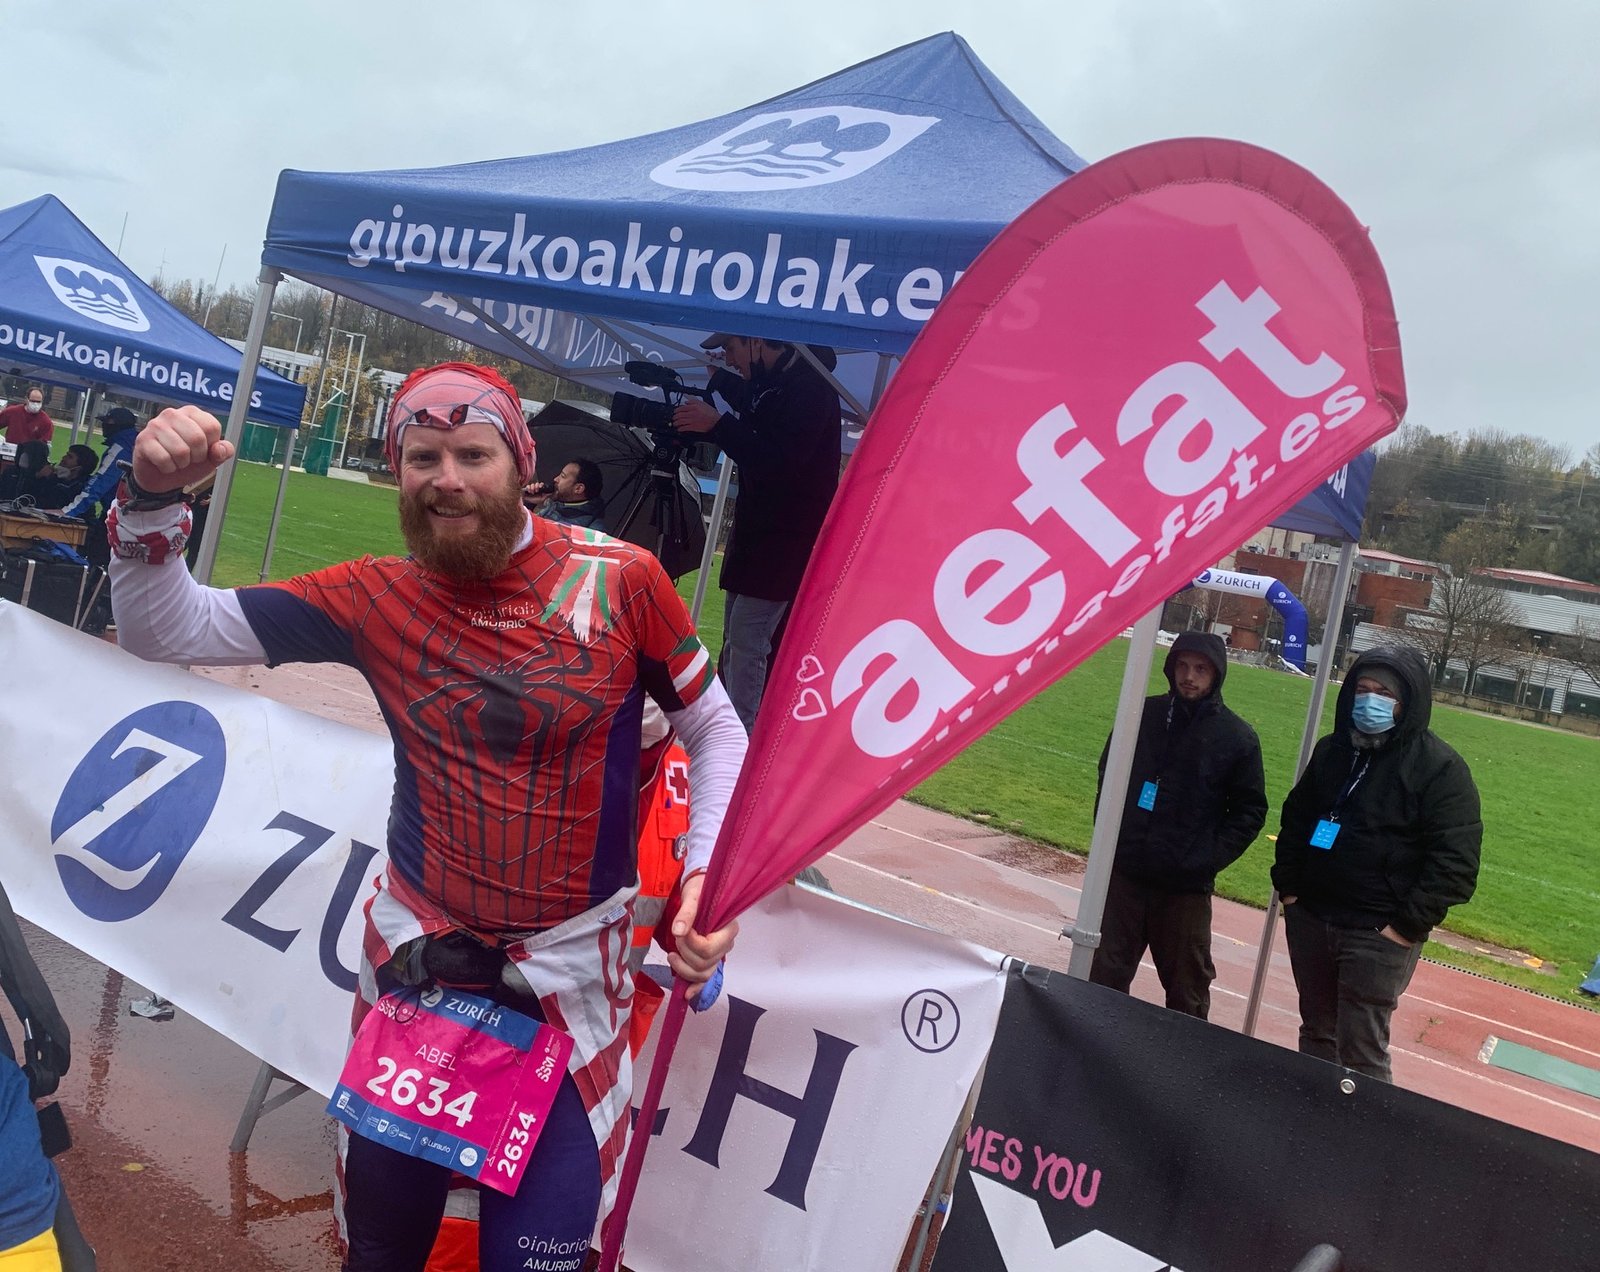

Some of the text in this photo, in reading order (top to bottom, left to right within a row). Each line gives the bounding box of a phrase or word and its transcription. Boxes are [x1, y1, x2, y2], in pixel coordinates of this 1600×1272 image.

[348, 204, 1047, 330] gipuzkoakirolak.es
[0, 324, 262, 409] uzkoakirolak.es
[831, 280, 1346, 757] aefat
[1215, 574, 1261, 590] ZURICH
[445, 997, 502, 1028] ZURICH
[415, 1043, 457, 1072] ABEL
[366, 1056, 478, 1128] 2634
[497, 1111, 537, 1179] 2634
[1032, 1145, 1102, 1208] YOU
[523, 1257, 581, 1272] AMURRIO
